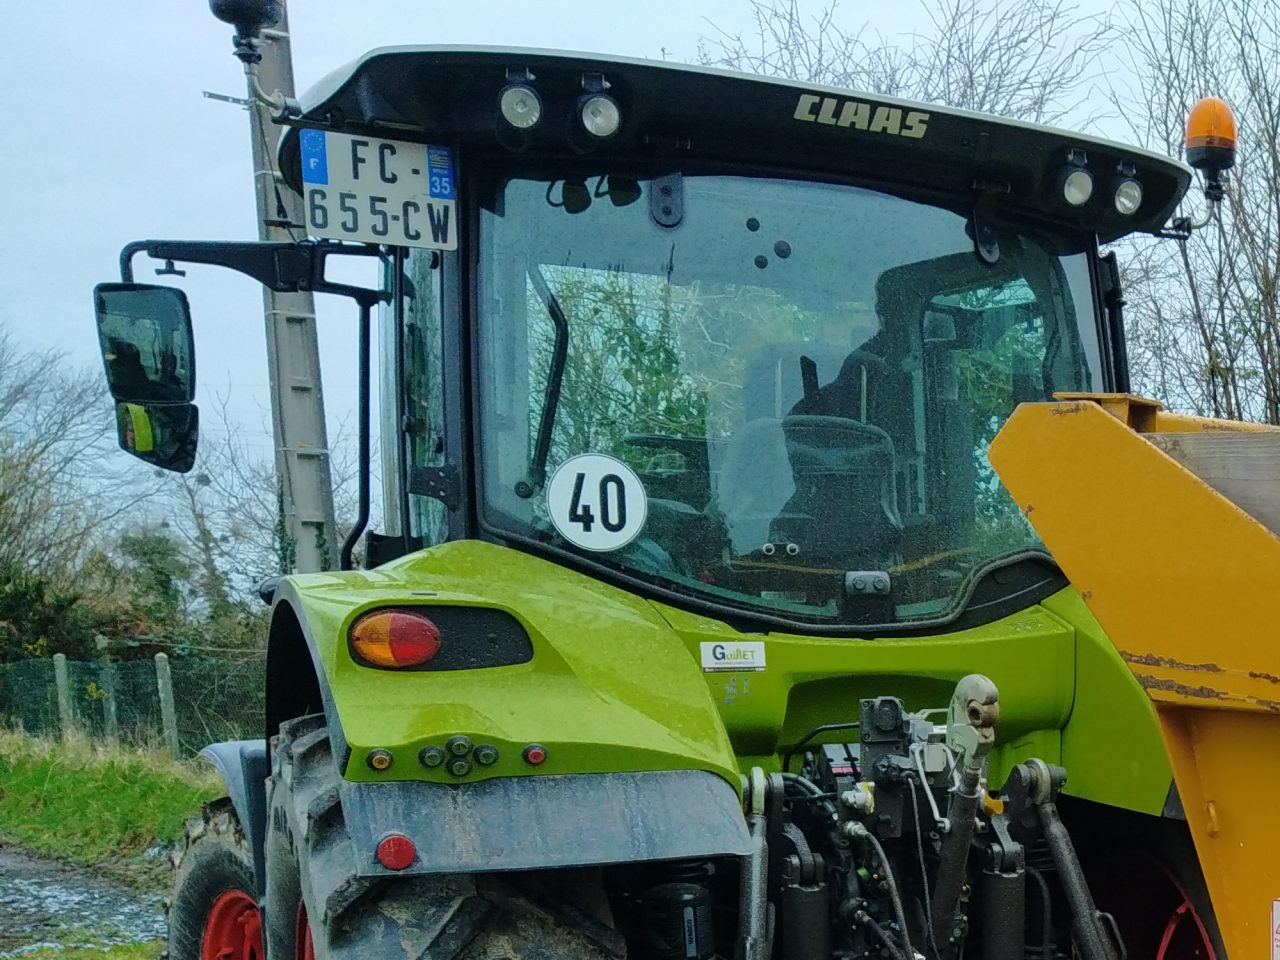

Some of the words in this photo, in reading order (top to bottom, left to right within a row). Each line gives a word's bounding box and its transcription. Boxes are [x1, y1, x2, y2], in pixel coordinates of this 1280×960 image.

[793, 93, 930, 139] CLAAS
[309, 158, 319, 169] F
[431, 177, 450, 194] 35
[308, 188, 450, 244] 655-CW
[568, 473, 627, 533] 40
